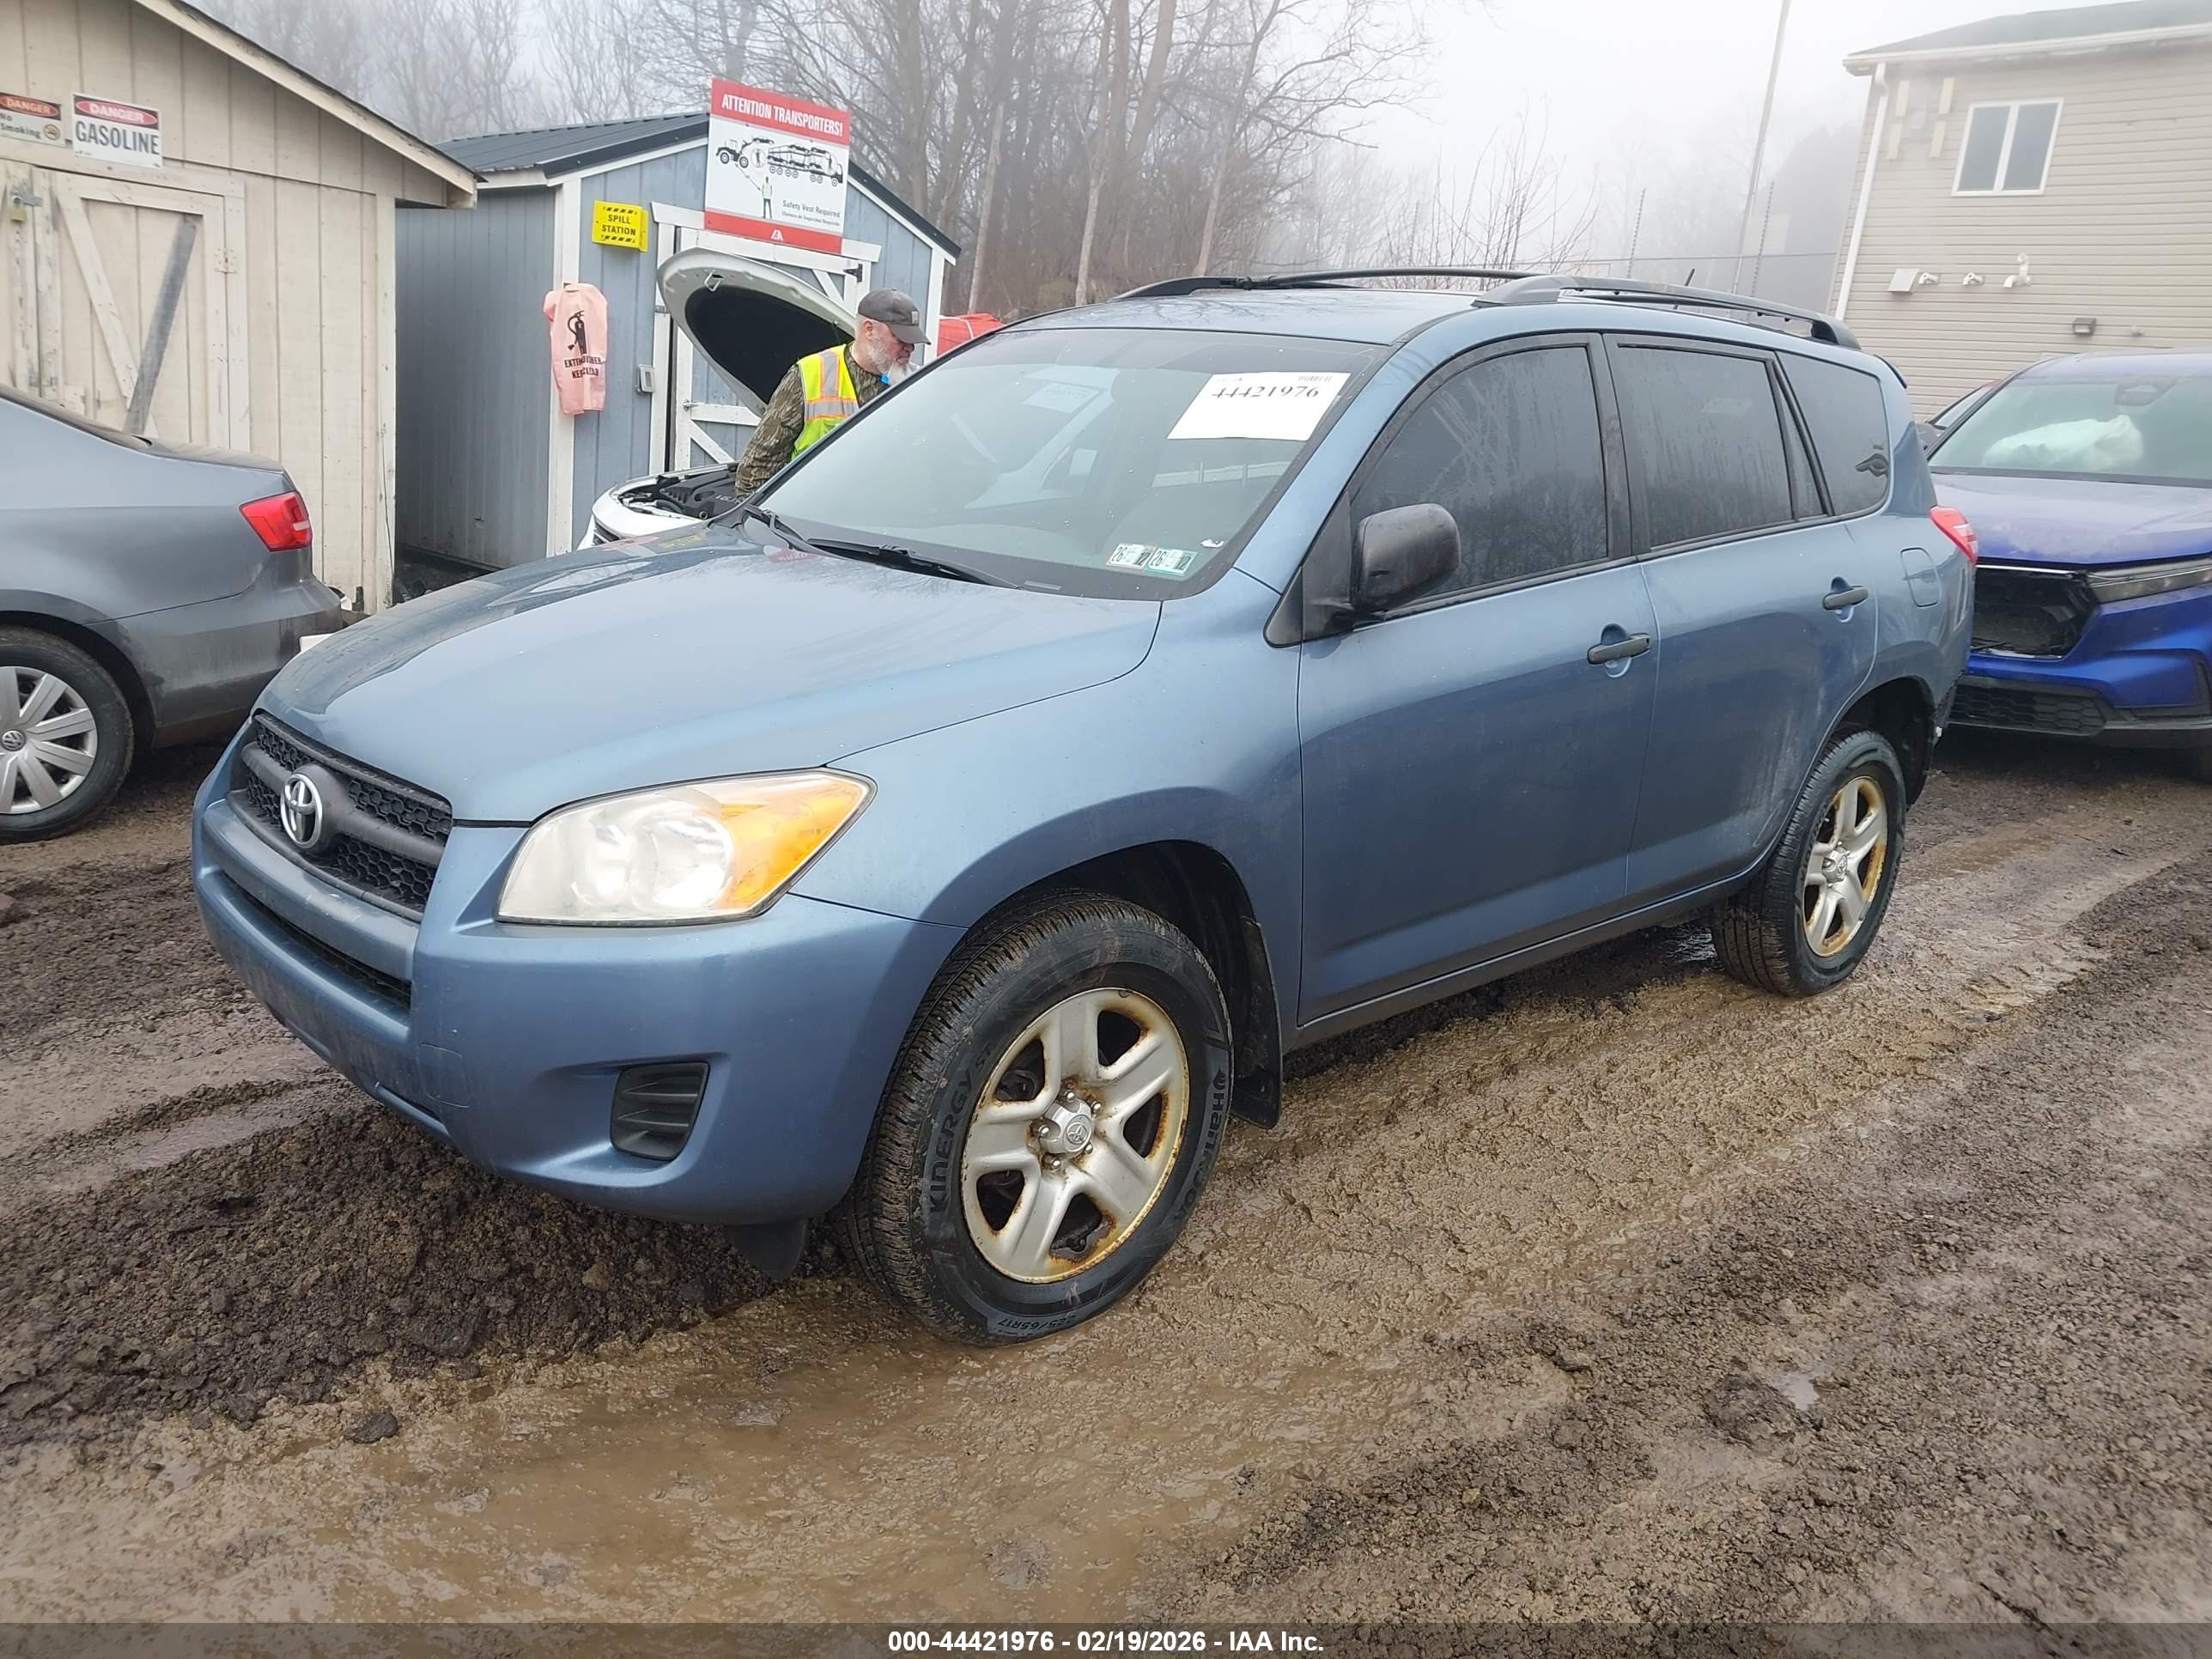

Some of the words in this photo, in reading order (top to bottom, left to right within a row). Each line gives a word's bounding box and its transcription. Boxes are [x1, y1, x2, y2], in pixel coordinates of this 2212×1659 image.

[7, 98, 51, 114] DANGER
[88, 102, 144, 123] DANGER
[721, 94, 772, 119] ATTENTION
[773, 106, 843, 137] TRANSPORTERS!
[76, 120, 160, 155] GASOLINE
[782, 199, 800, 211] Safety
[802, 204, 815, 213] Vest
[815, 206, 841, 218] Required
[607, 214, 631, 224] SPILL
[602, 224, 636, 236] STATION
[1212, 386, 1319, 399] 44421976
